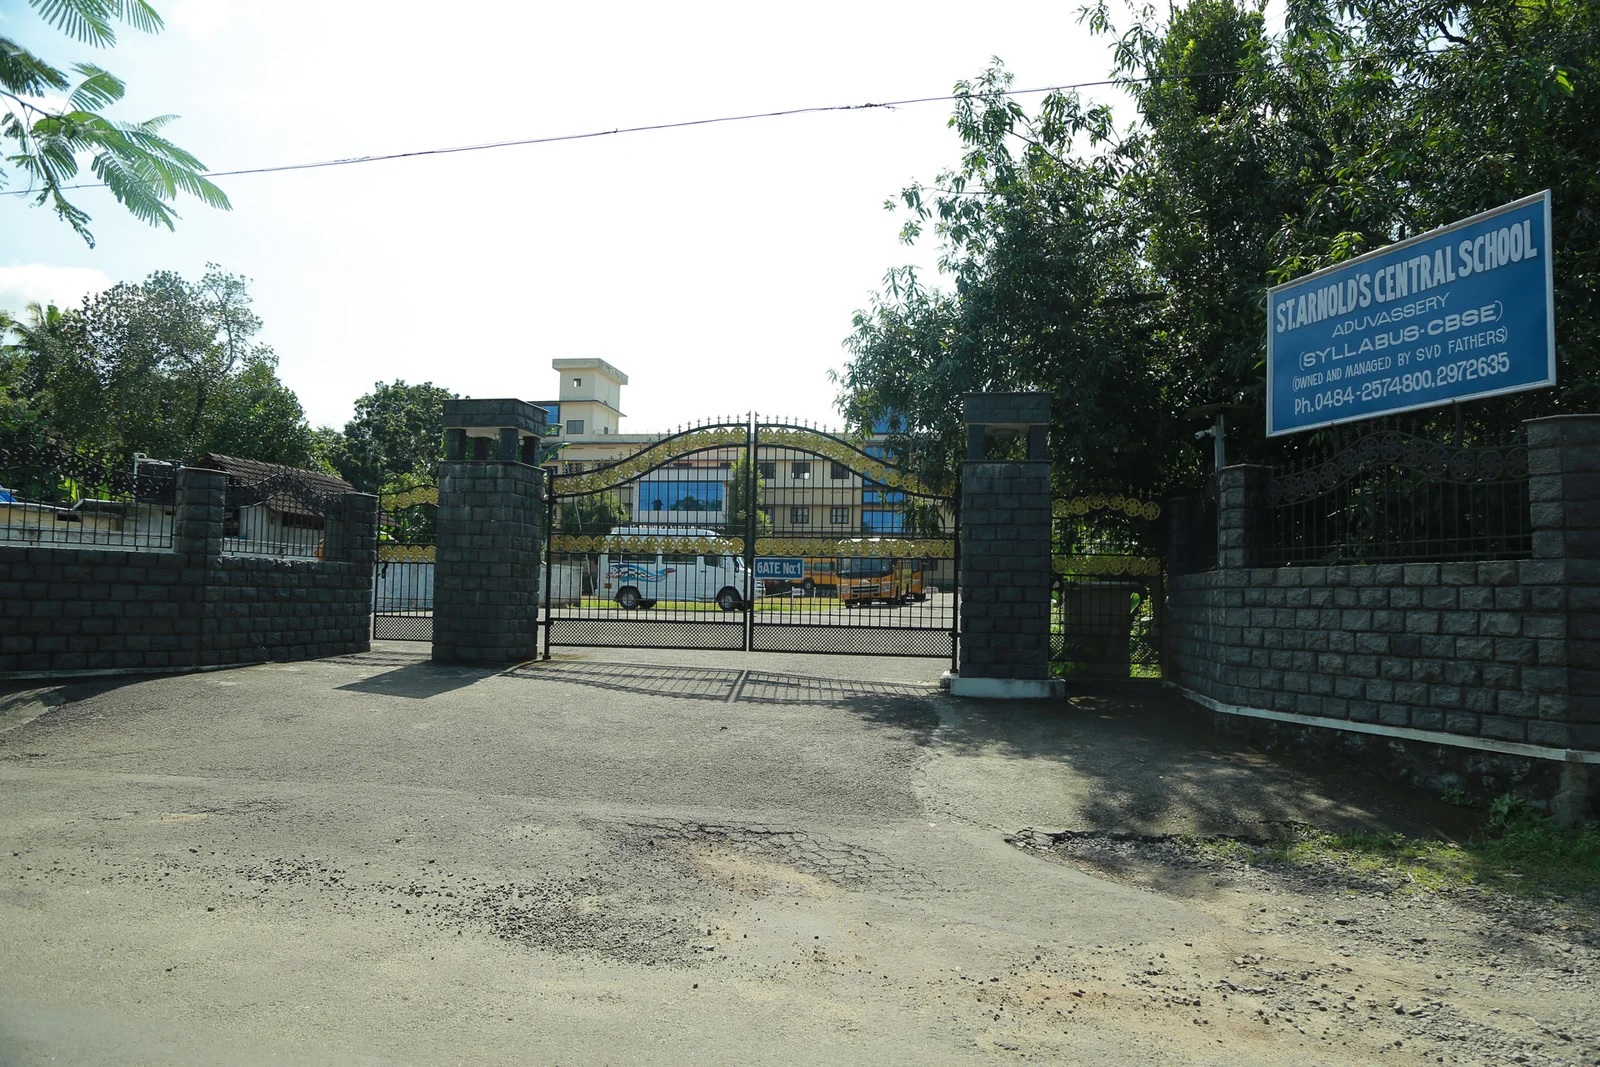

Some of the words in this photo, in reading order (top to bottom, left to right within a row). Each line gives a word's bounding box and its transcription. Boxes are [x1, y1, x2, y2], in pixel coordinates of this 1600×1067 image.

[1374, 245, 1456, 303] CENTRAL
[1458, 219, 1538, 278] SCHOOL
[1331, 292, 1450, 338] ADUVASSERY
[1292, 372, 1324, 393] (OWNED
[1325, 367, 1342, 383] AND
[1345, 356, 1392, 379] MANAGED
[1397, 351, 1411, 367] BY
[1416, 344, 1442, 362] SVD
[1448, 325, 1508, 355] FATHERS)
[757, 562, 781, 574] GATE
